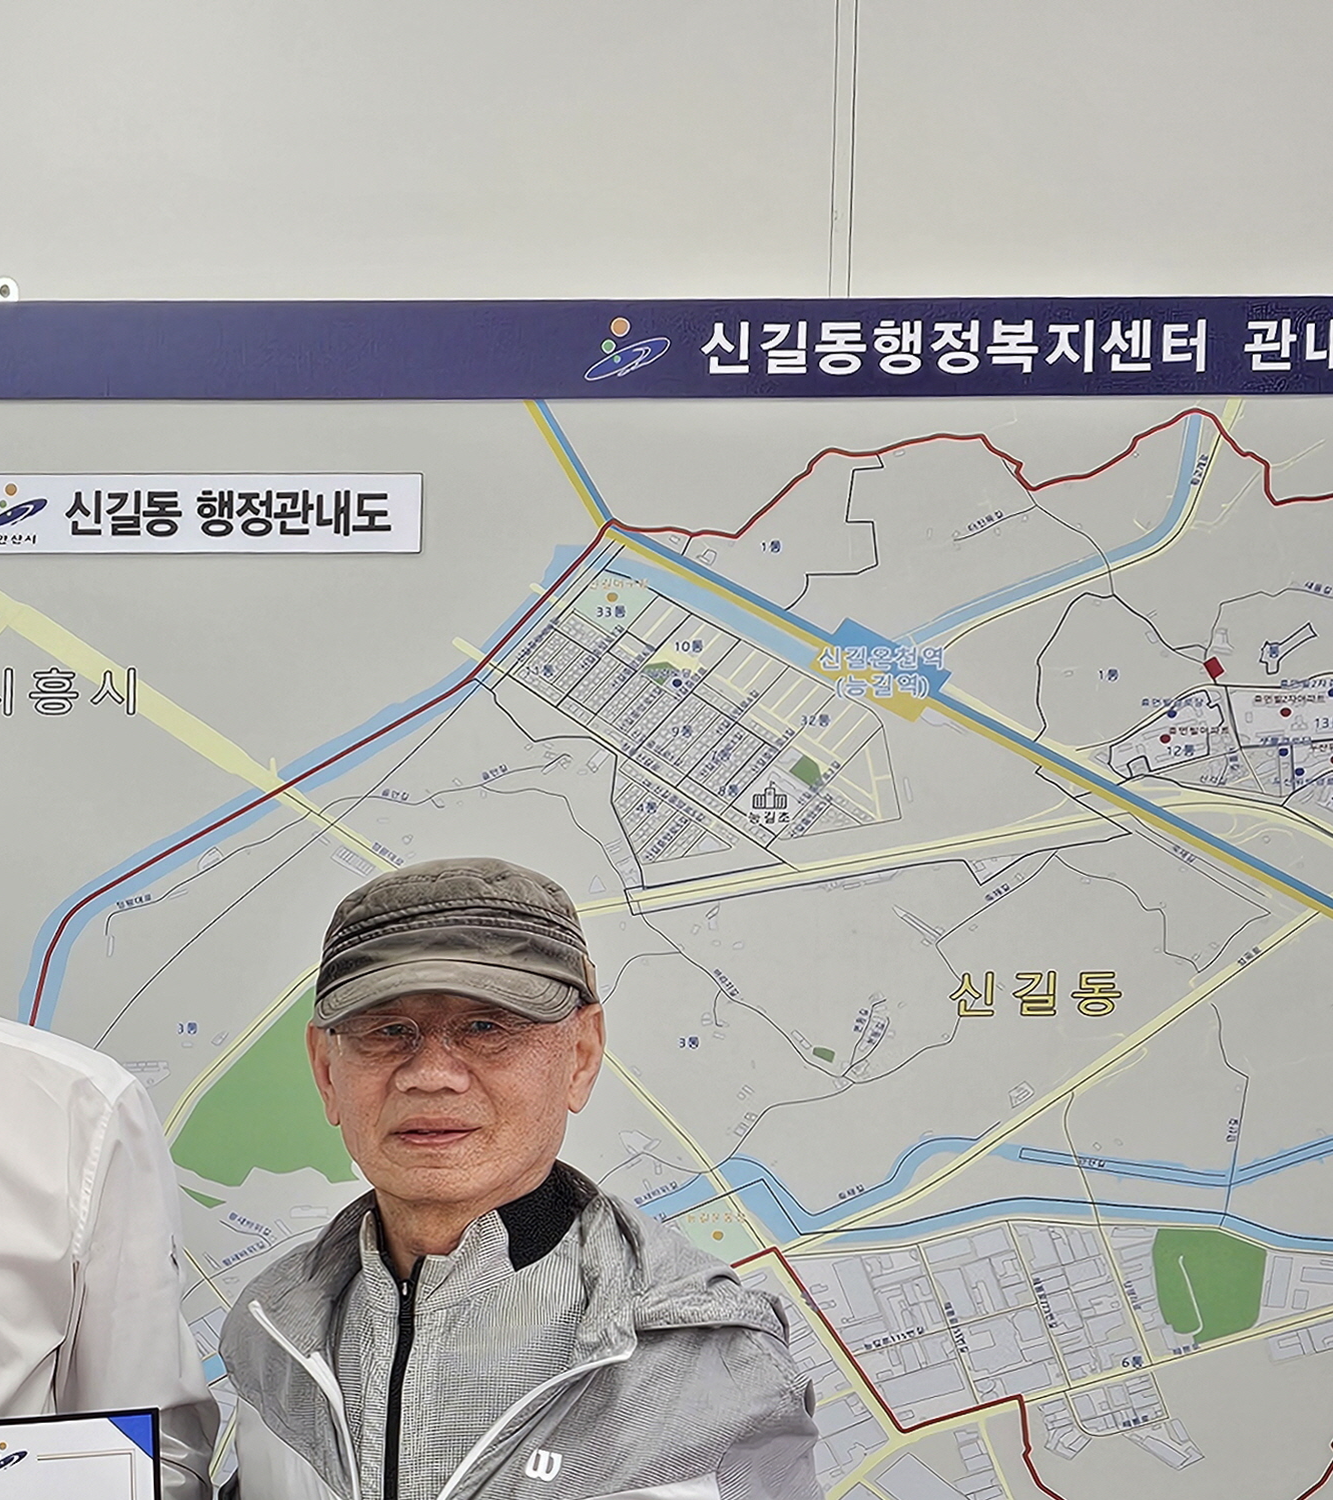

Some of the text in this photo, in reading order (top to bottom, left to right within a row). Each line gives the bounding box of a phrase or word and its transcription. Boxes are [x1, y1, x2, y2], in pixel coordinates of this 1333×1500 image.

[700, 318, 1206, 376] 신길동행정복지센터
[66, 489, 392, 537] 신길동 행정관내도
[820, 647, 943, 670] 신길온천역
[836, 675, 928, 699] (능길역)
[948, 970, 1122, 1017] 신길동
